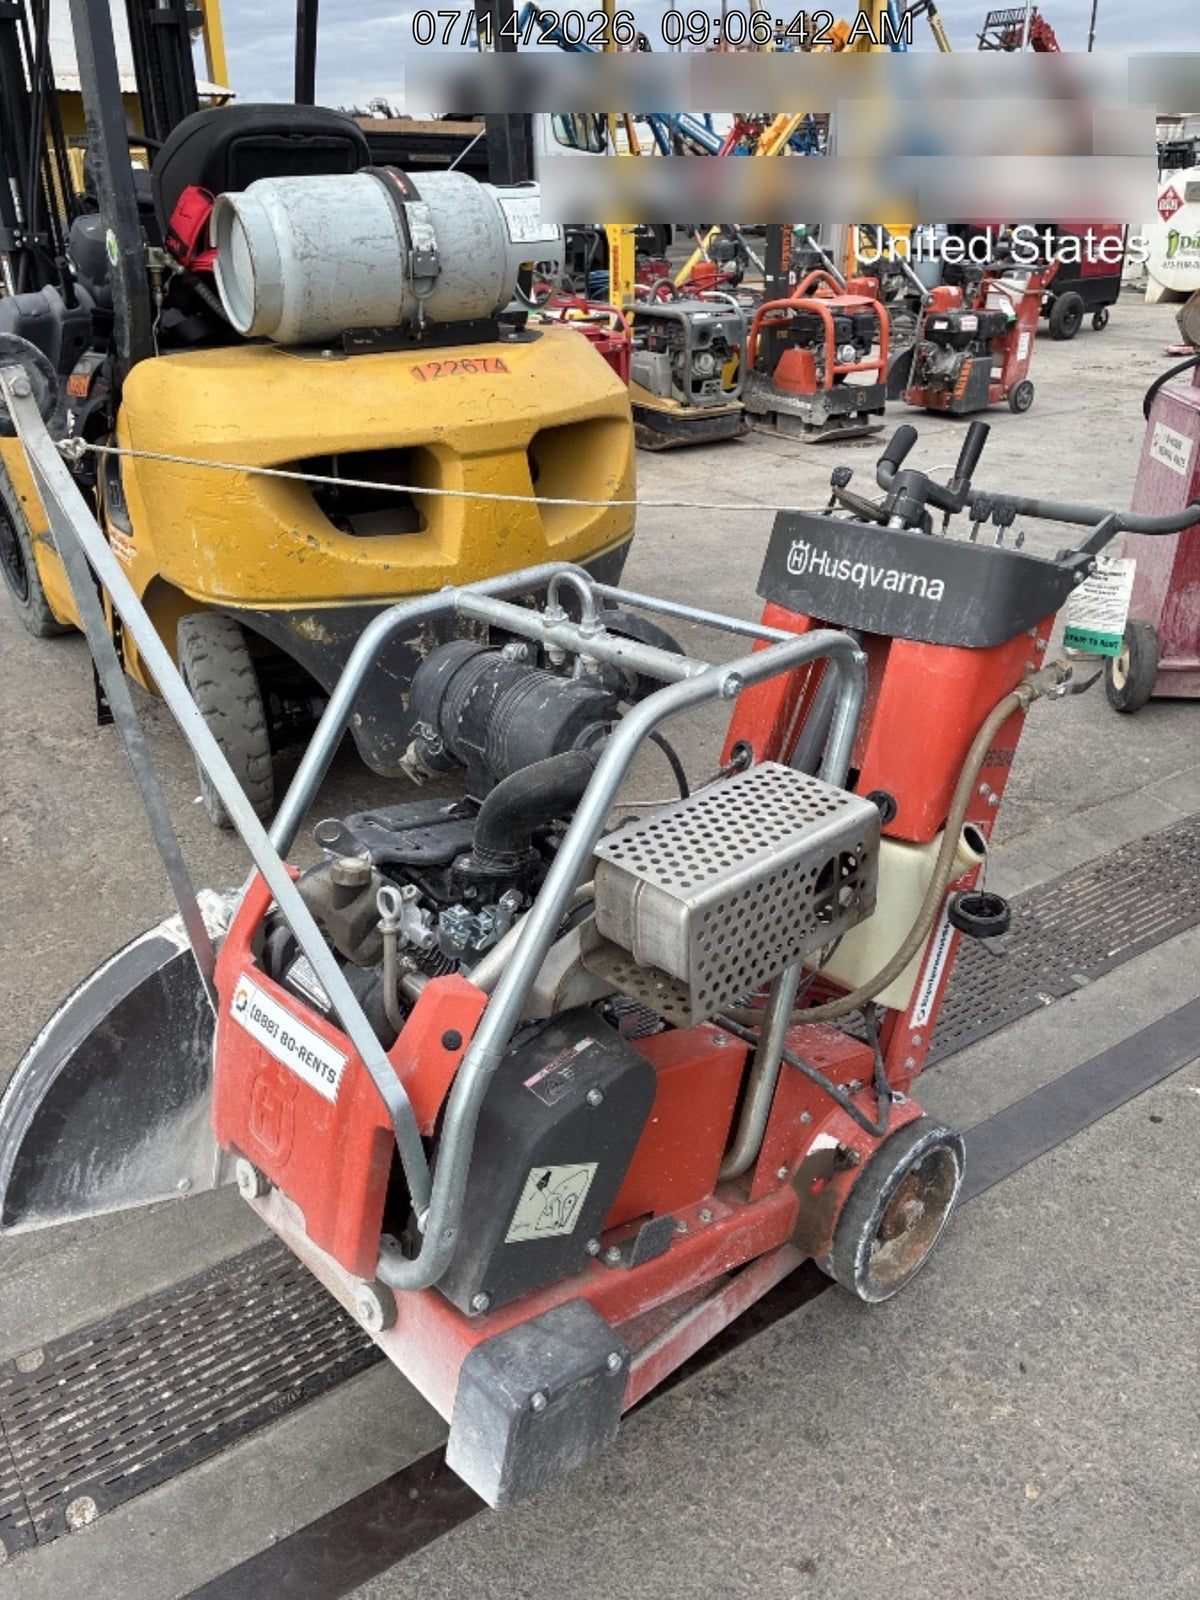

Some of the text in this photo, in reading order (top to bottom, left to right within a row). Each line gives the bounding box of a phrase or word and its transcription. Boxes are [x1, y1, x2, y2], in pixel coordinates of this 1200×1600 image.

[809, 548, 945, 600] Husqvarna
[250, 1003, 337, 1085] (888) 80-RENTS
